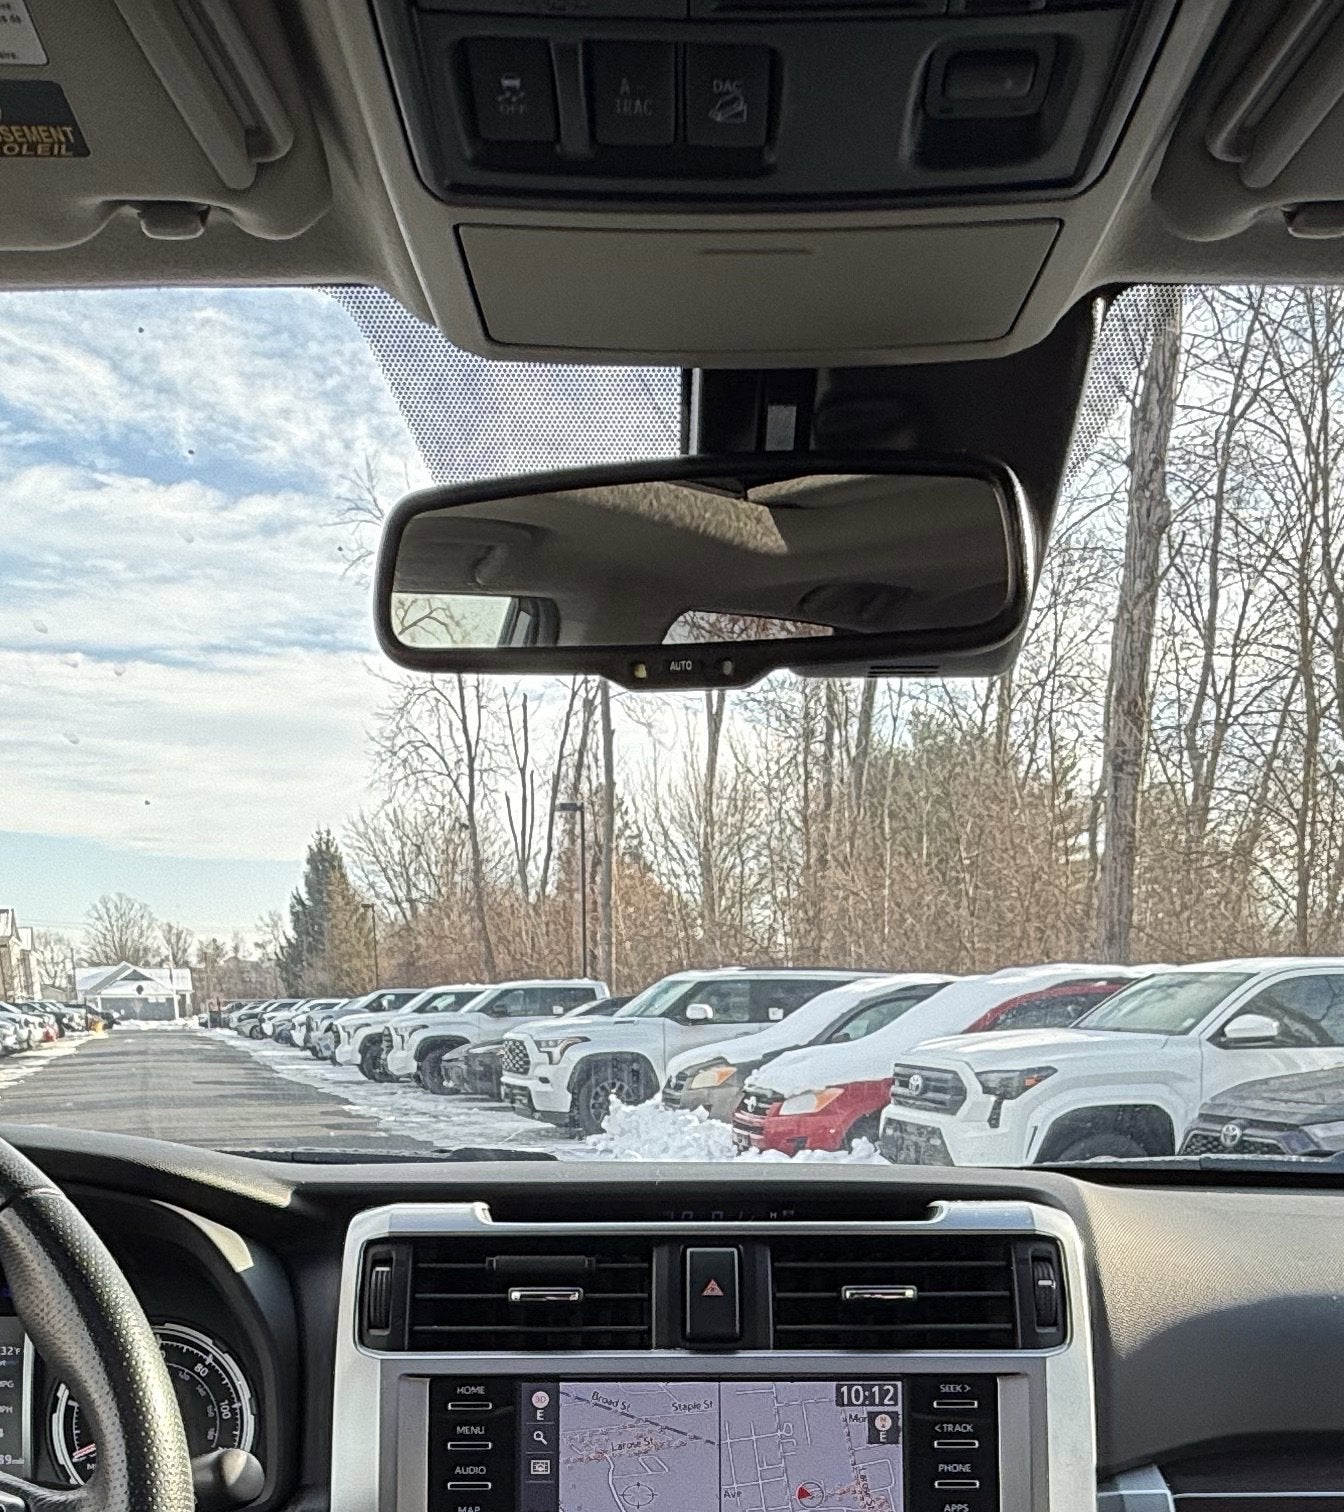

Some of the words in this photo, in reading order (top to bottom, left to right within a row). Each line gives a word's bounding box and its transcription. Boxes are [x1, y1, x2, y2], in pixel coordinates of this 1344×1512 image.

[713, 79, 742, 93] DAC
[669, 660, 693, 671] AUTO
[194, 1363, 209, 1377] 80
[456, 1386, 486, 1395] HOME
[940, 1384, 962, 1394] SEEK
[840, 1385, 895, 1405] 10:12
[591, 1391, 620, 1408] Broad
[621, 1400, 631, 1411] St
[703, 1400, 713, 1409] St
[219, 1399, 232, 1420] 100
[536, 1410, 544, 1421] E
[456, 1426, 485, 1435] MENU
[942, 1423, 974, 1433] TRACK
[879, 1431, 887, 1442] E
[454, 1466, 487, 1475] AUDIO
[938, 1463, 972, 1473] PHONE
[723, 1489, 743, 1499] Ave
